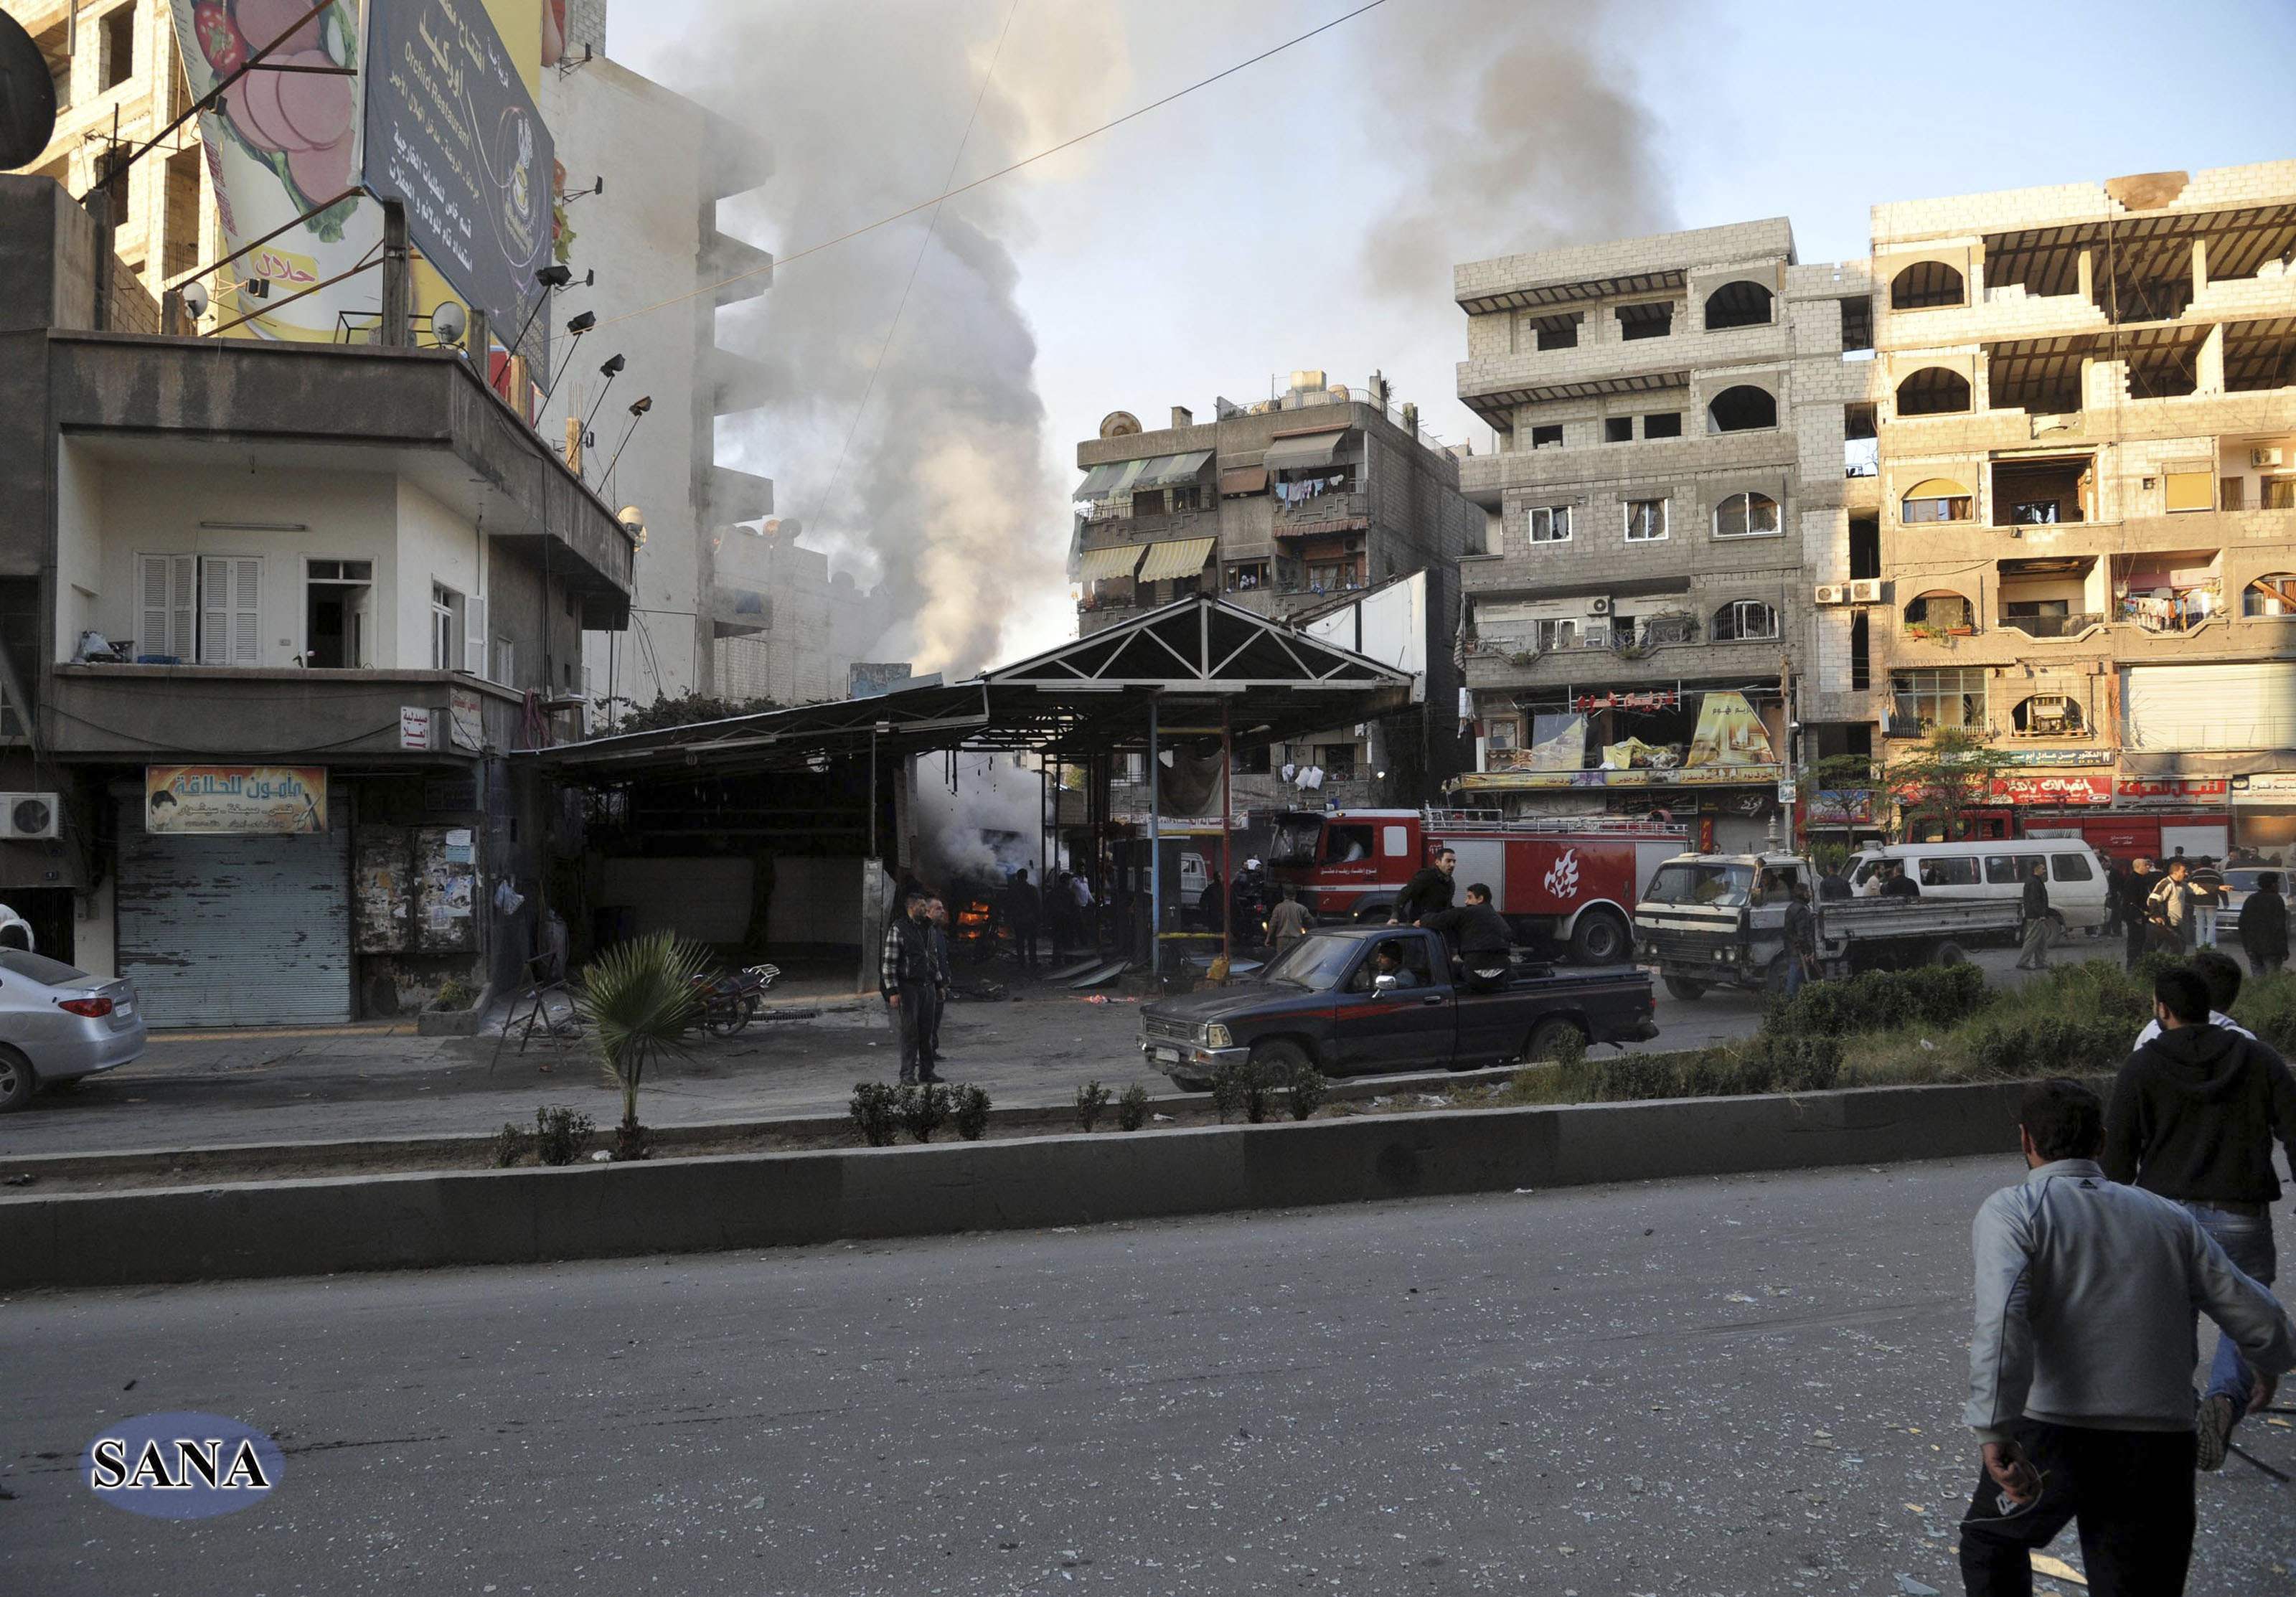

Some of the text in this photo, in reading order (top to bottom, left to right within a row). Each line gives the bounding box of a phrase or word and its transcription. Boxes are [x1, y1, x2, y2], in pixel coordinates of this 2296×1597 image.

[404, 41, 471, 151] Orchid Restaurant
[255, 253, 316, 283] حلال
[403, 708, 428, 726] صيدلية
[2079, 750, 2102, 761] الدكتور
[174, 772, 303, 799] مأمون للحلاقة
